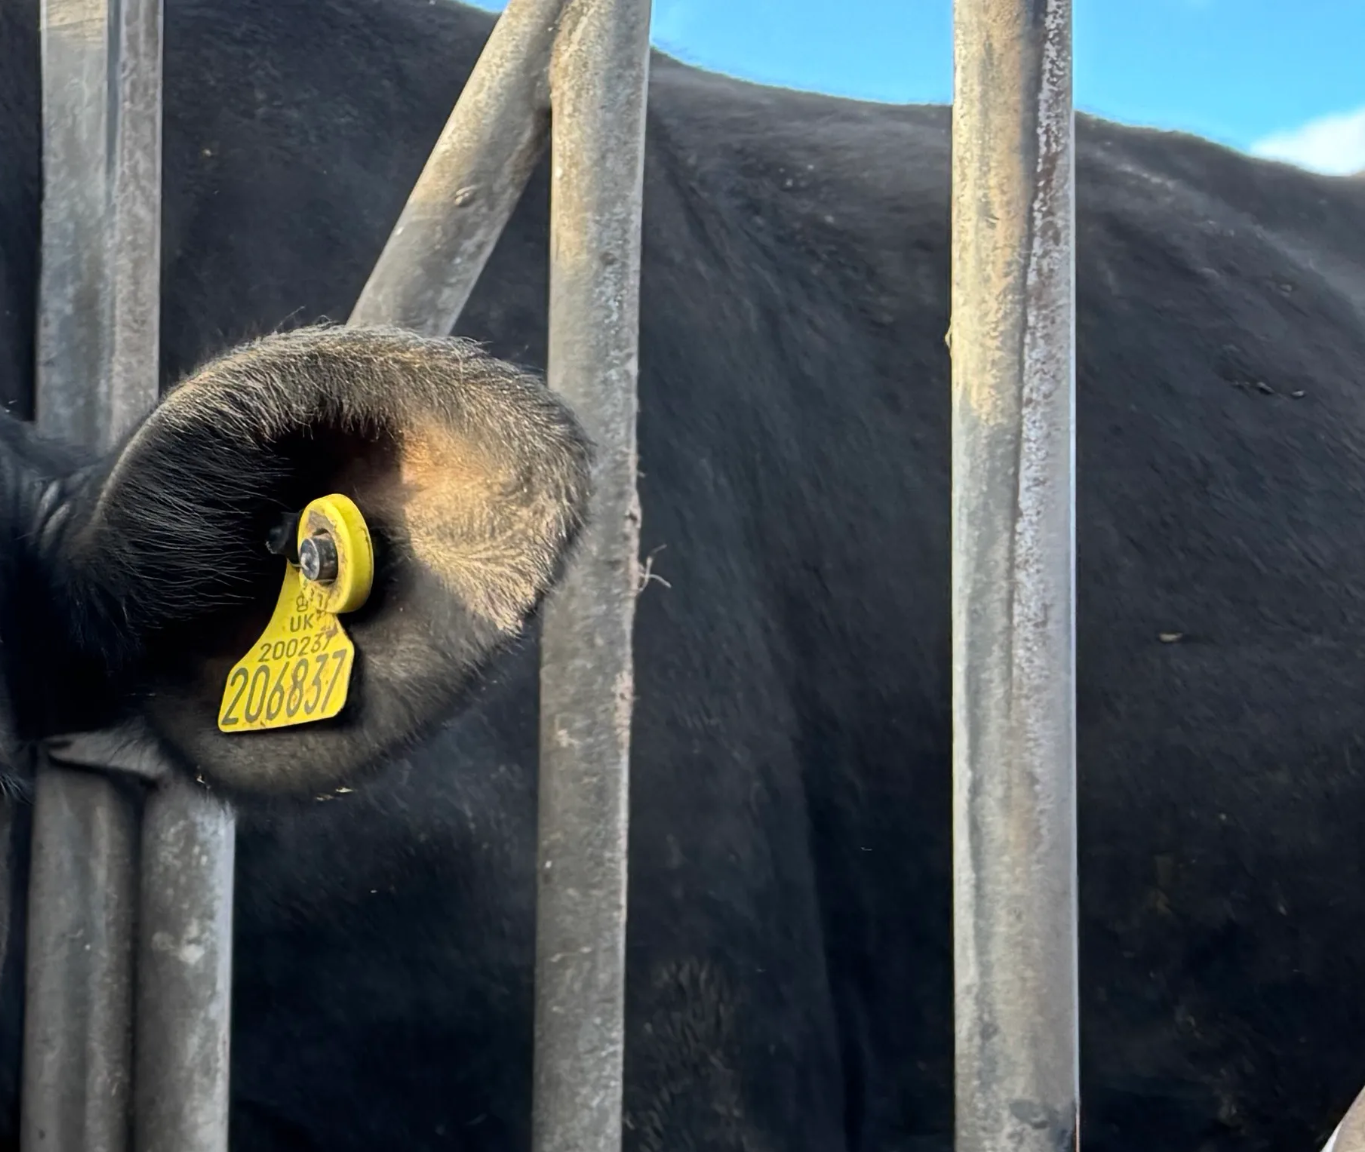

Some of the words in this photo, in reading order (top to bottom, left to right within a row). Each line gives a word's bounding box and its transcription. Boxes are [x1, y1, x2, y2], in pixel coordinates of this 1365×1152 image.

[290, 614, 314, 633] UK
[258, 633, 333, 663] 200237
[221, 648, 347, 726] 206837
